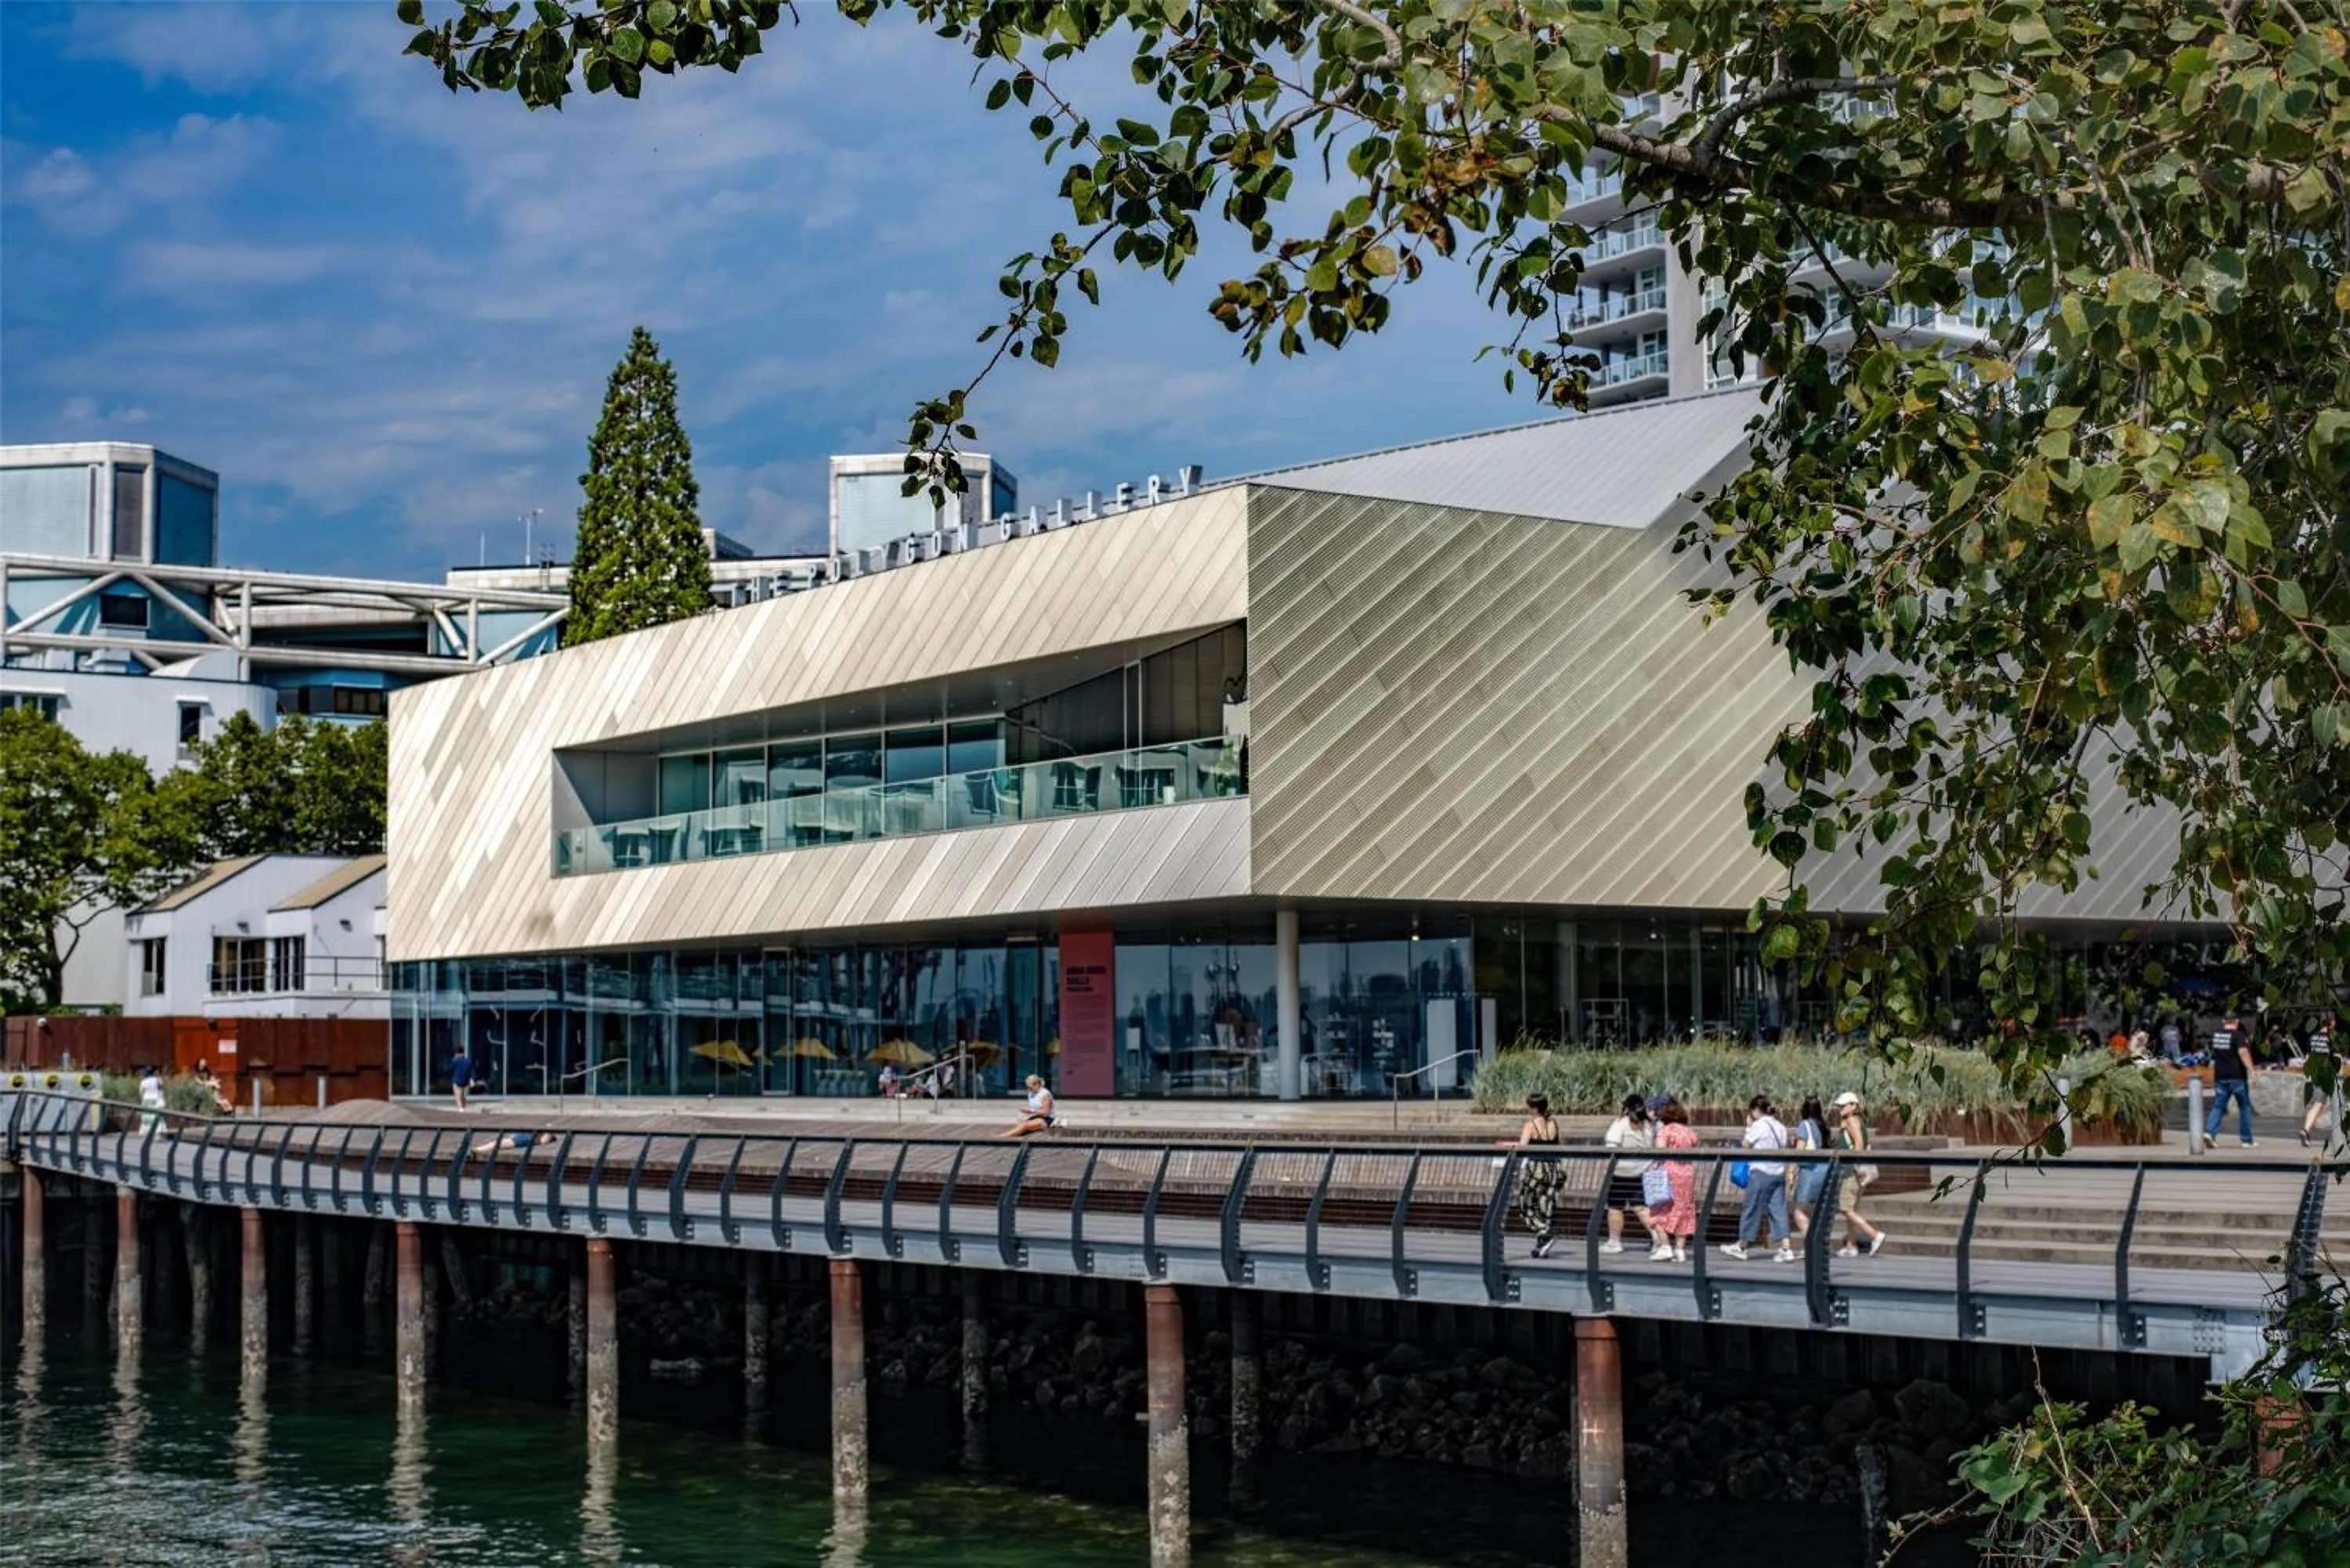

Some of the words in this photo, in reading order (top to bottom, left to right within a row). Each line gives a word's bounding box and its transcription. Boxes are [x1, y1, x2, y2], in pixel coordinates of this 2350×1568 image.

[726, 572, 786, 608] THE
[807, 522, 970, 589] POLYGON
[1000, 465, 1194, 540] GALLERY
